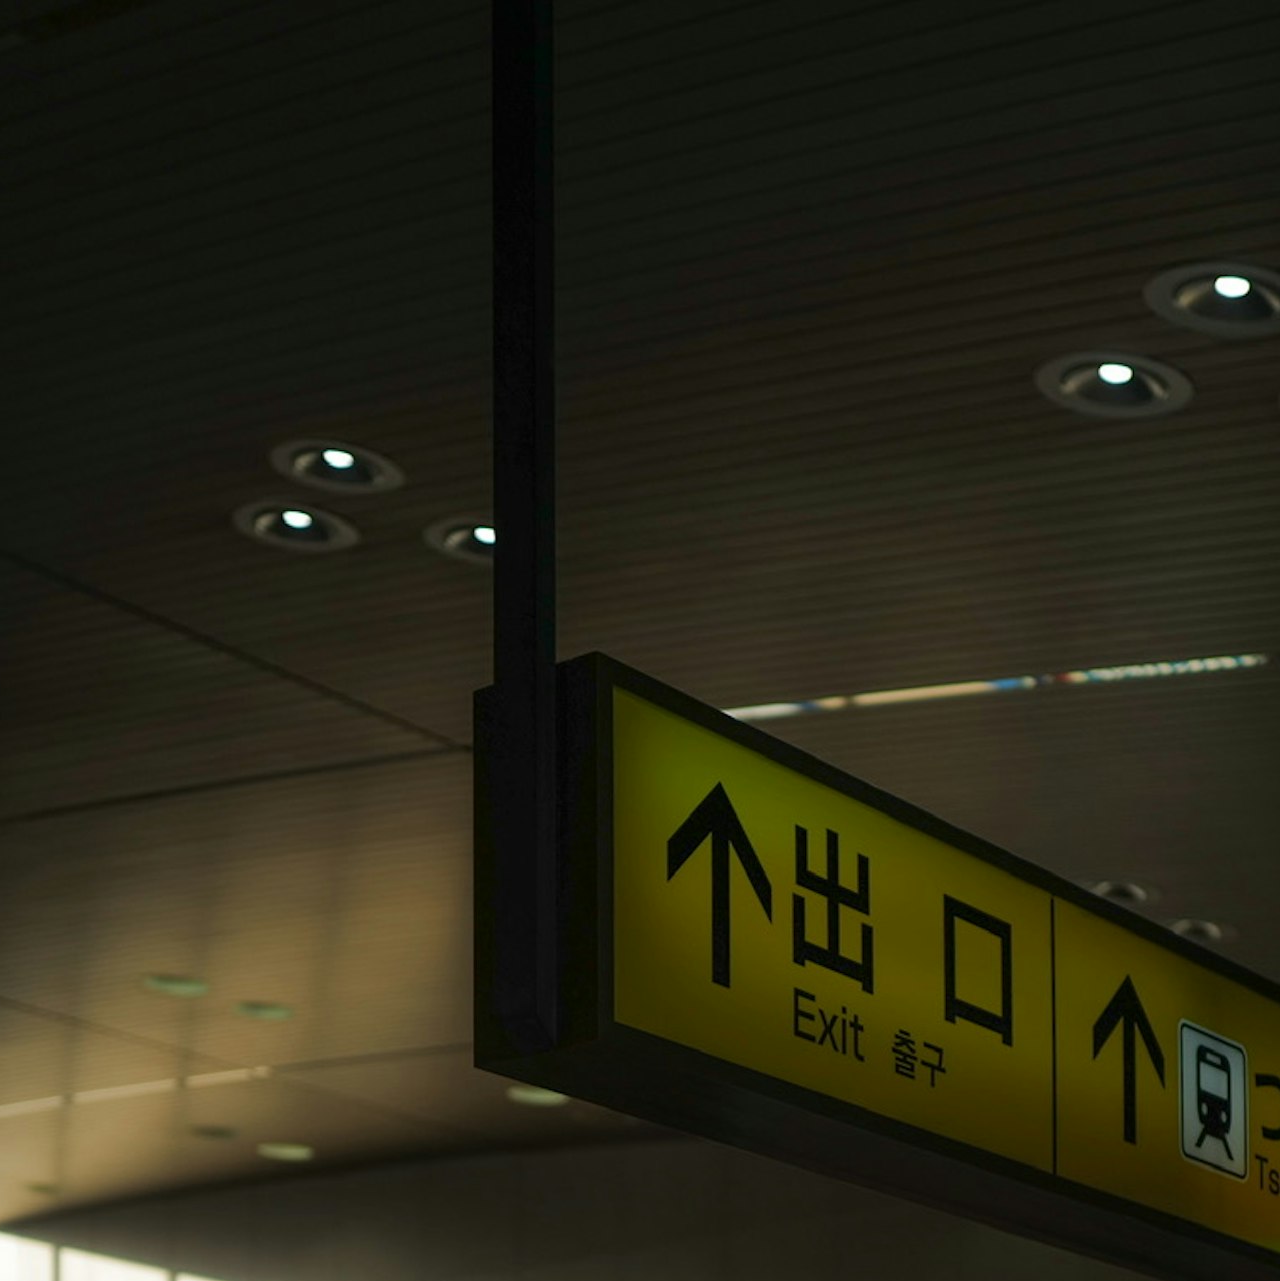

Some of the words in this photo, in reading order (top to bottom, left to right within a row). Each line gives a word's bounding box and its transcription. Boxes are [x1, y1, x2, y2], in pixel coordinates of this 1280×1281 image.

[793, 824, 1014, 1047] 出口
[793, 987, 865, 1061] Exit
[892, 1029, 947, 1088] 출구
